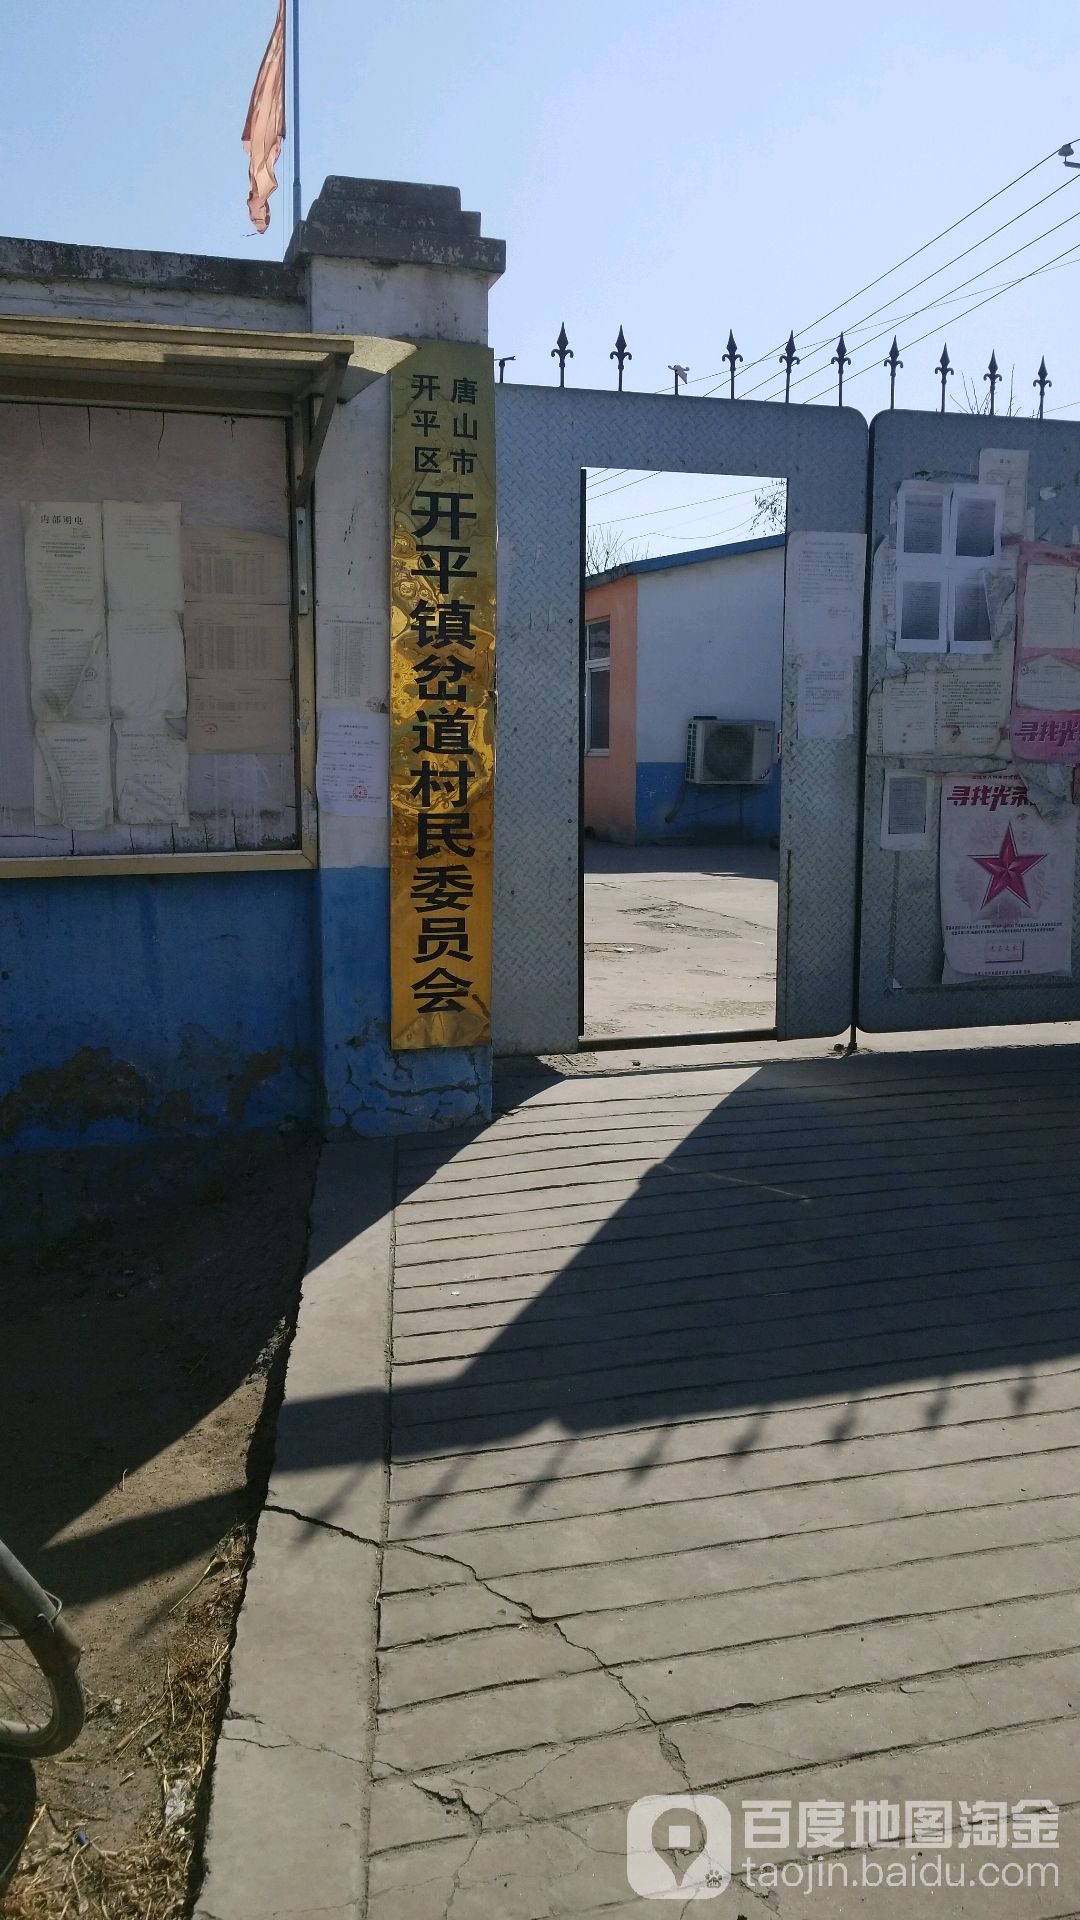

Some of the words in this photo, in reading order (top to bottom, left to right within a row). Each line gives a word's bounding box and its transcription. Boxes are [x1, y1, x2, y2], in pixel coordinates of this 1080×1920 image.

[411, 374, 441, 474] 开平区
[450, 377, 478, 476] 唐山市
[410, 490, 478, 1014] 开平镇岔道村民委员会
